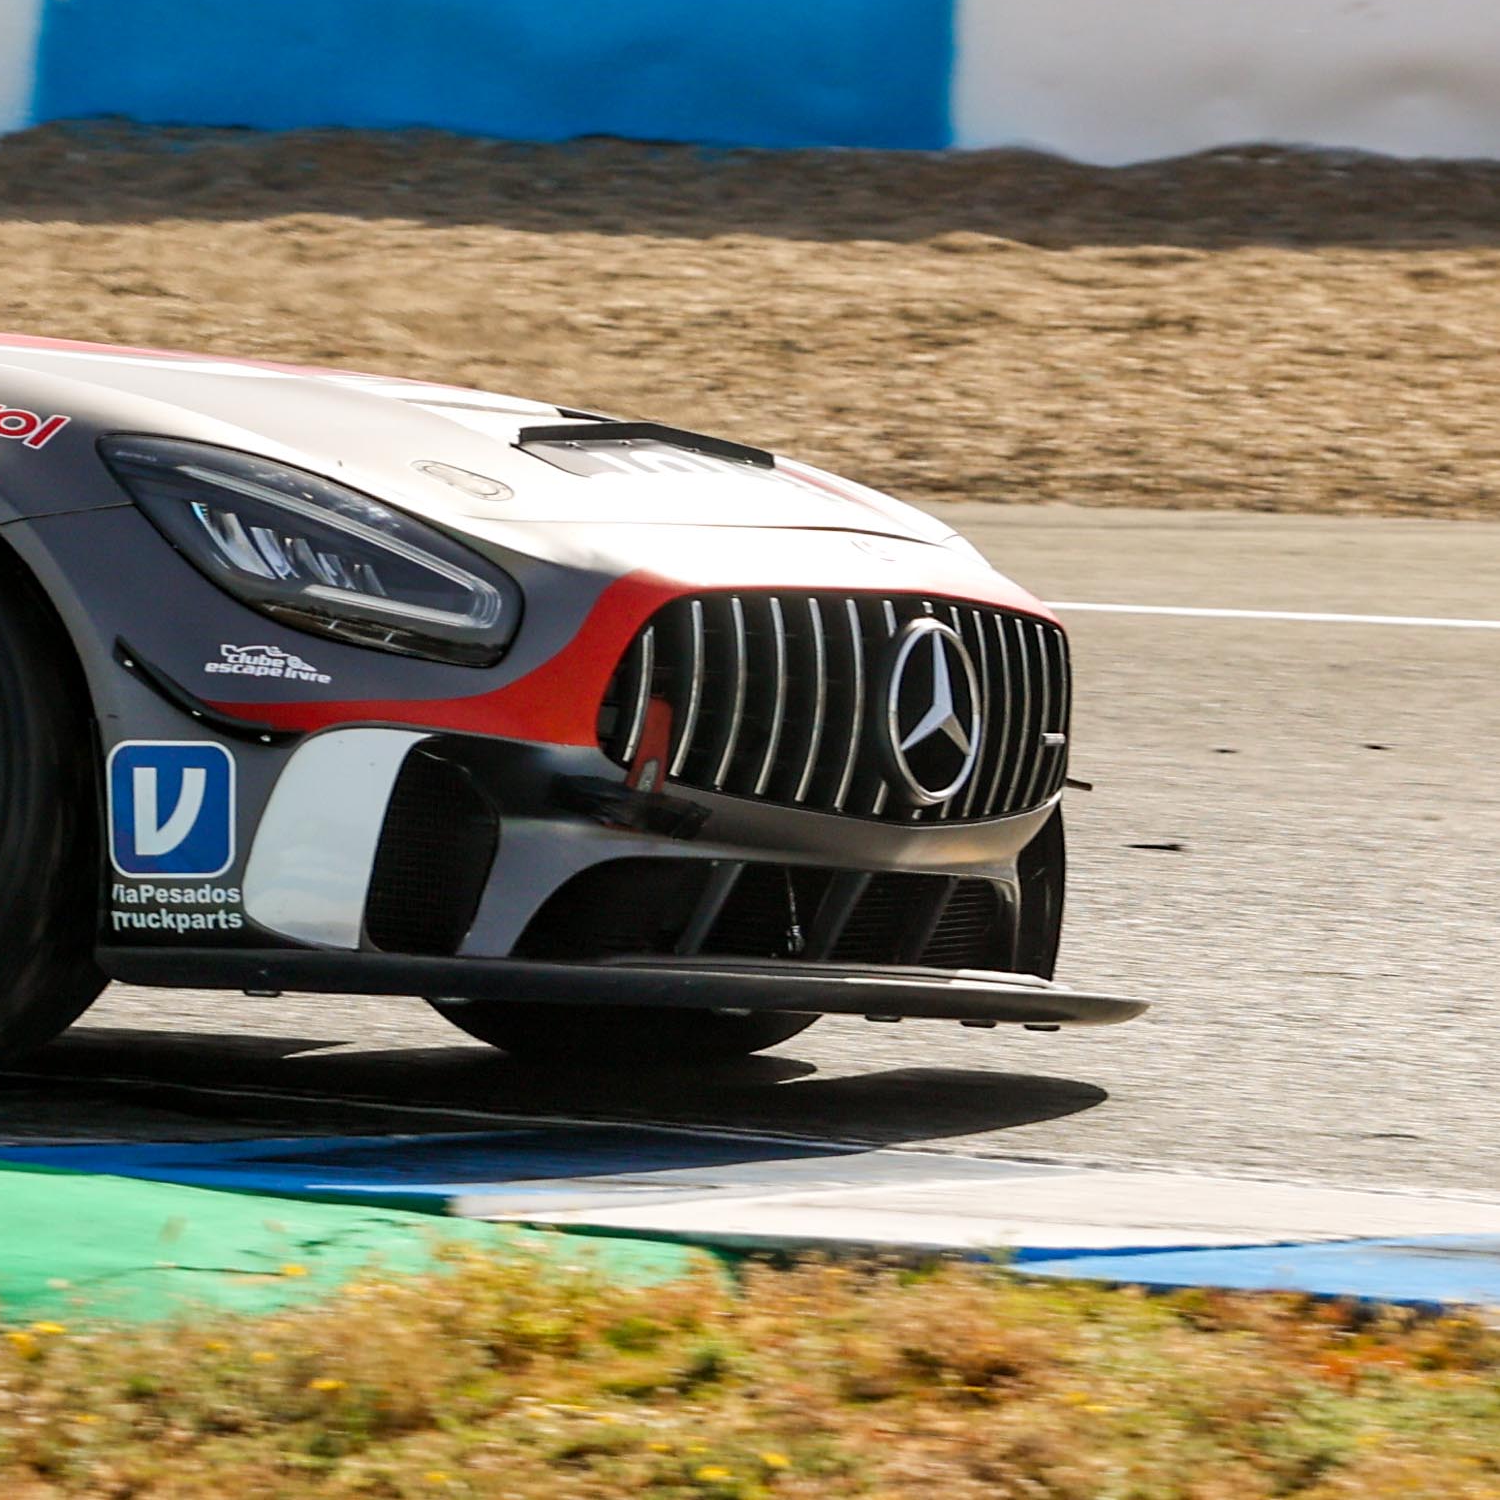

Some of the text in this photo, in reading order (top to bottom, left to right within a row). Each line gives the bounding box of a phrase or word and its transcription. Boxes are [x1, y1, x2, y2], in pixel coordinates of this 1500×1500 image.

[227, 652, 285, 668] clube
[204, 662, 283, 677] escape
[111, 908, 243, 934] Truckparts
